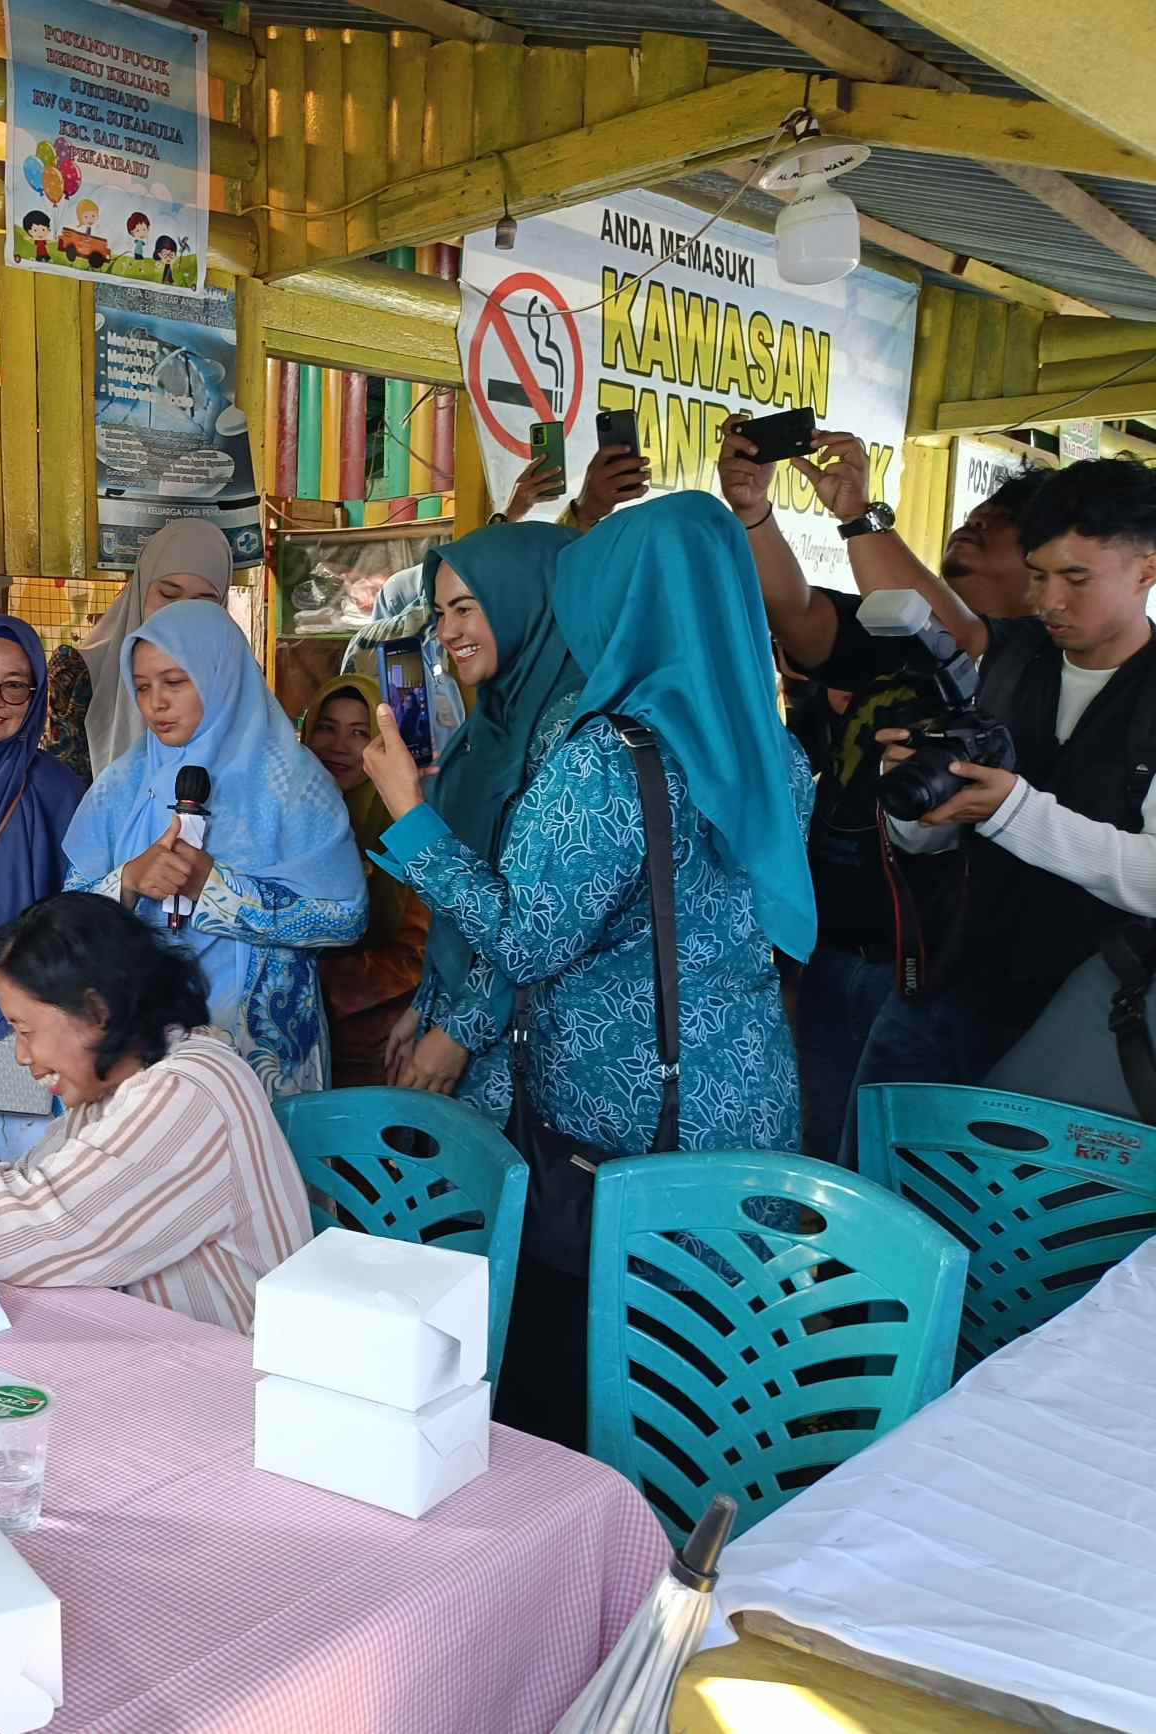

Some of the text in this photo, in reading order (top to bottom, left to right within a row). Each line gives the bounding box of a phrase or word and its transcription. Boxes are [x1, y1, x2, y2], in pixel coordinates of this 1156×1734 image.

[122, 48, 170, 76] PUCUK
[601, 208, 755, 288] ANDA MEMASUKI
[602, 266, 831, 420] KAWASAN
